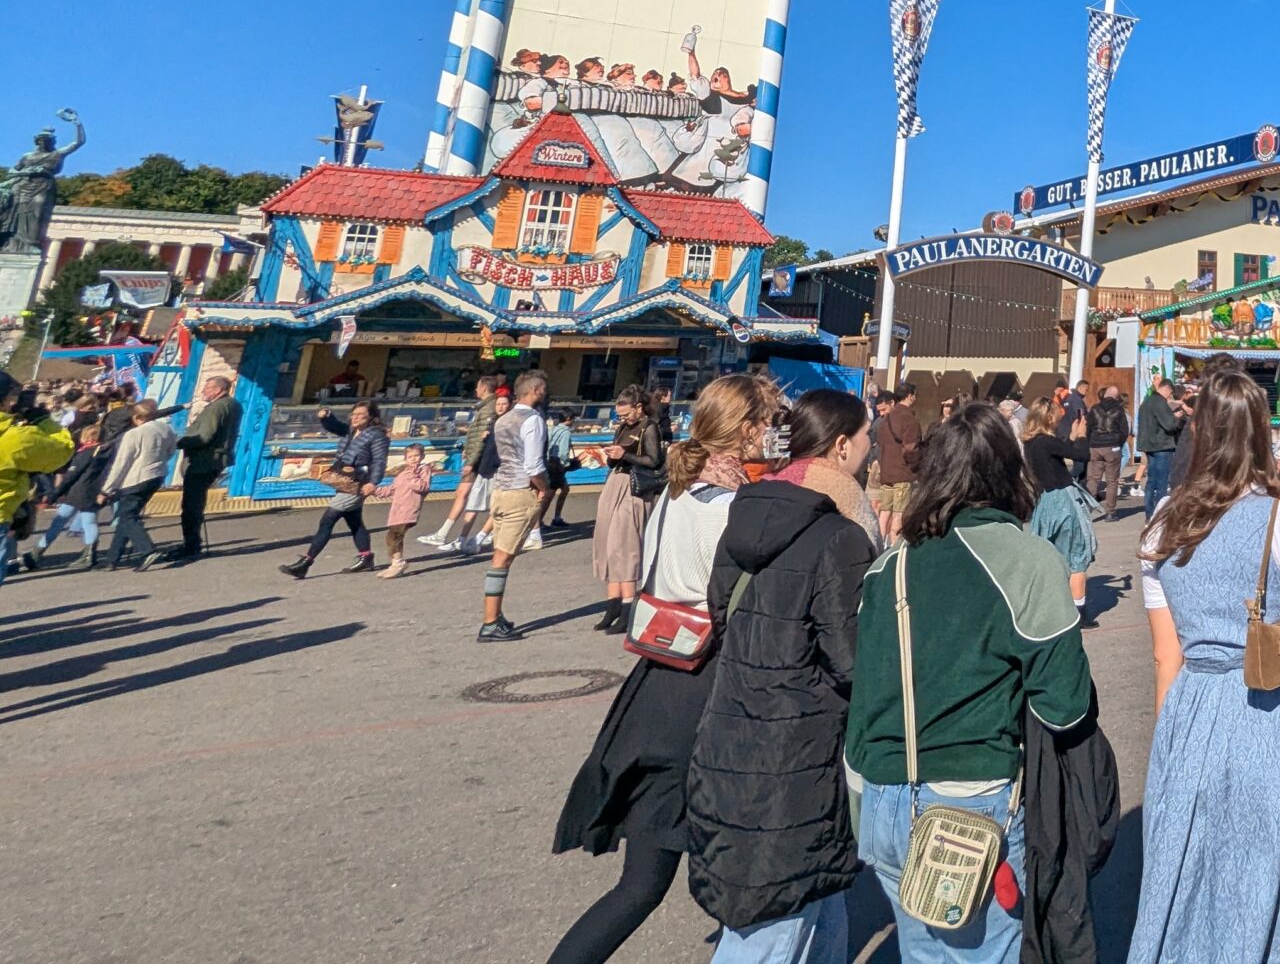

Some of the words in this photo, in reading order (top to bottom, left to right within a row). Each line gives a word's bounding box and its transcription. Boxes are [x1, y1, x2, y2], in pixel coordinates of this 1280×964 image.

[540, 147, 583, 163] Winters
[1047, 183, 1077, 204] GUT,
[1080, 169, 1137, 197] BSSER,
[1140, 145, 1235, 182] PAULANER.
[470, 248, 534, 286] FISCH
[552, 261, 614, 287] HAUS
[893, 237, 1097, 284] PAULANERGARTEN
